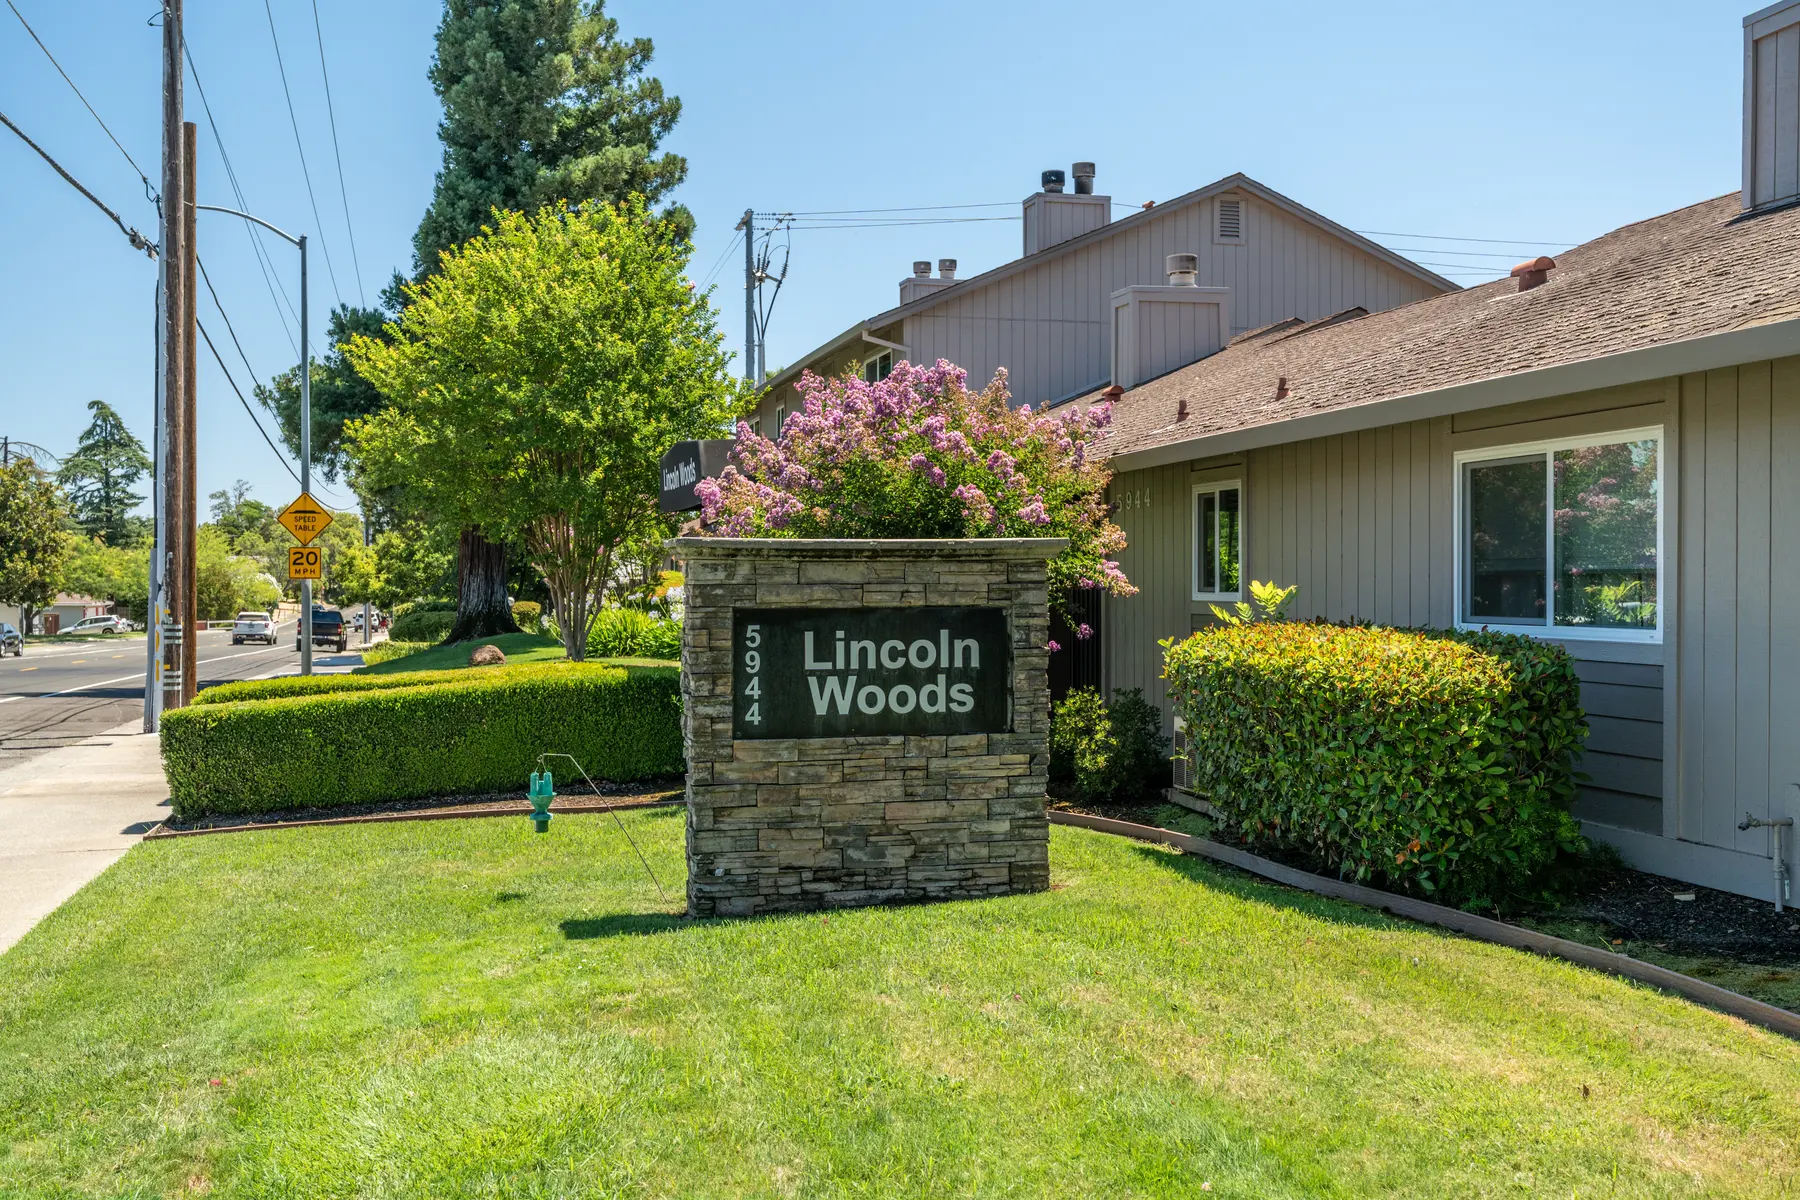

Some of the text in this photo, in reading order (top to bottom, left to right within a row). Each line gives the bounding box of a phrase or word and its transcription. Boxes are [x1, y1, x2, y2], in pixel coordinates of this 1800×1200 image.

[663, 457, 696, 491] Lincoln Woods
[1116, 487, 1151, 512] 5944
[294, 515, 317, 523] SPEED
[294, 524, 317, 532] TABLE
[292, 551, 318, 566] 20
[804, 629, 980, 670] Lincoln
[745, 624, 762, 726] 5944
[807, 674, 975, 716] Woods
